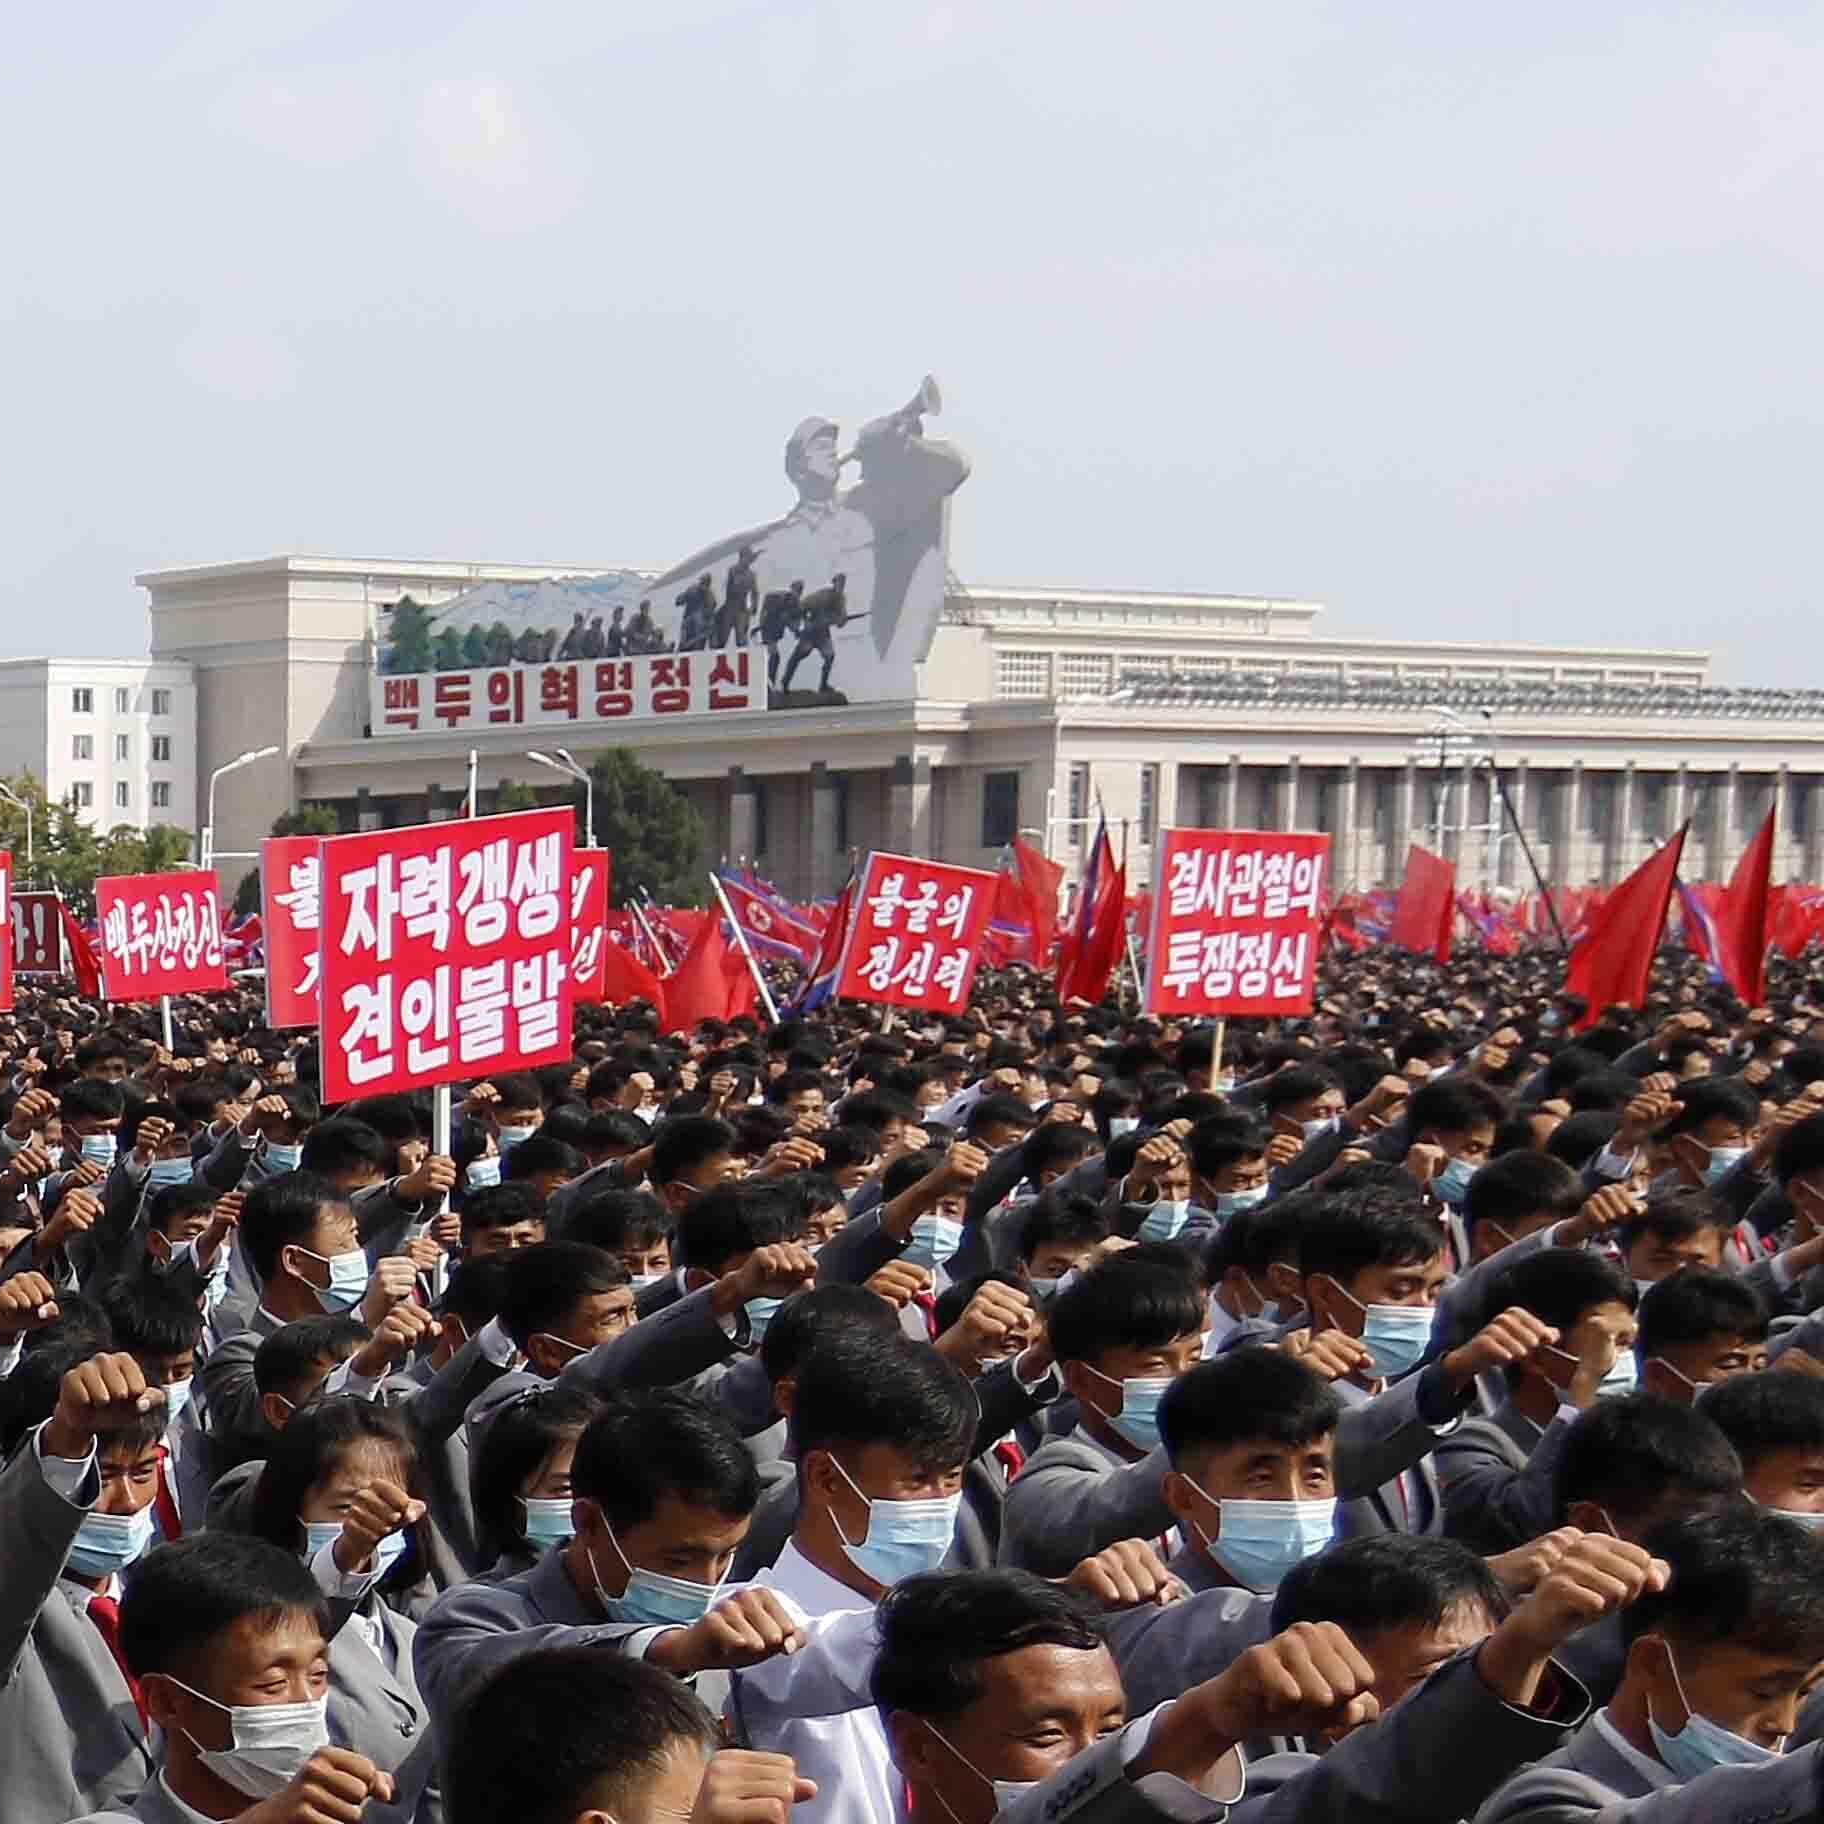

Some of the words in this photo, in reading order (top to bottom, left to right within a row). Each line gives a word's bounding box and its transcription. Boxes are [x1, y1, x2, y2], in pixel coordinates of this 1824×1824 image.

[341, 831, 562, 961] 자력갱생
[867, 870, 974, 934] 불굴의
[1168, 848, 1322, 919] 결사관철의
[104, 896, 222, 976] 백두산정신
[1161, 930, 1308, 999] 투쟁정신
[859, 941, 970, 1003] 정신력
[341, 949, 567, 1085] 견인불발
